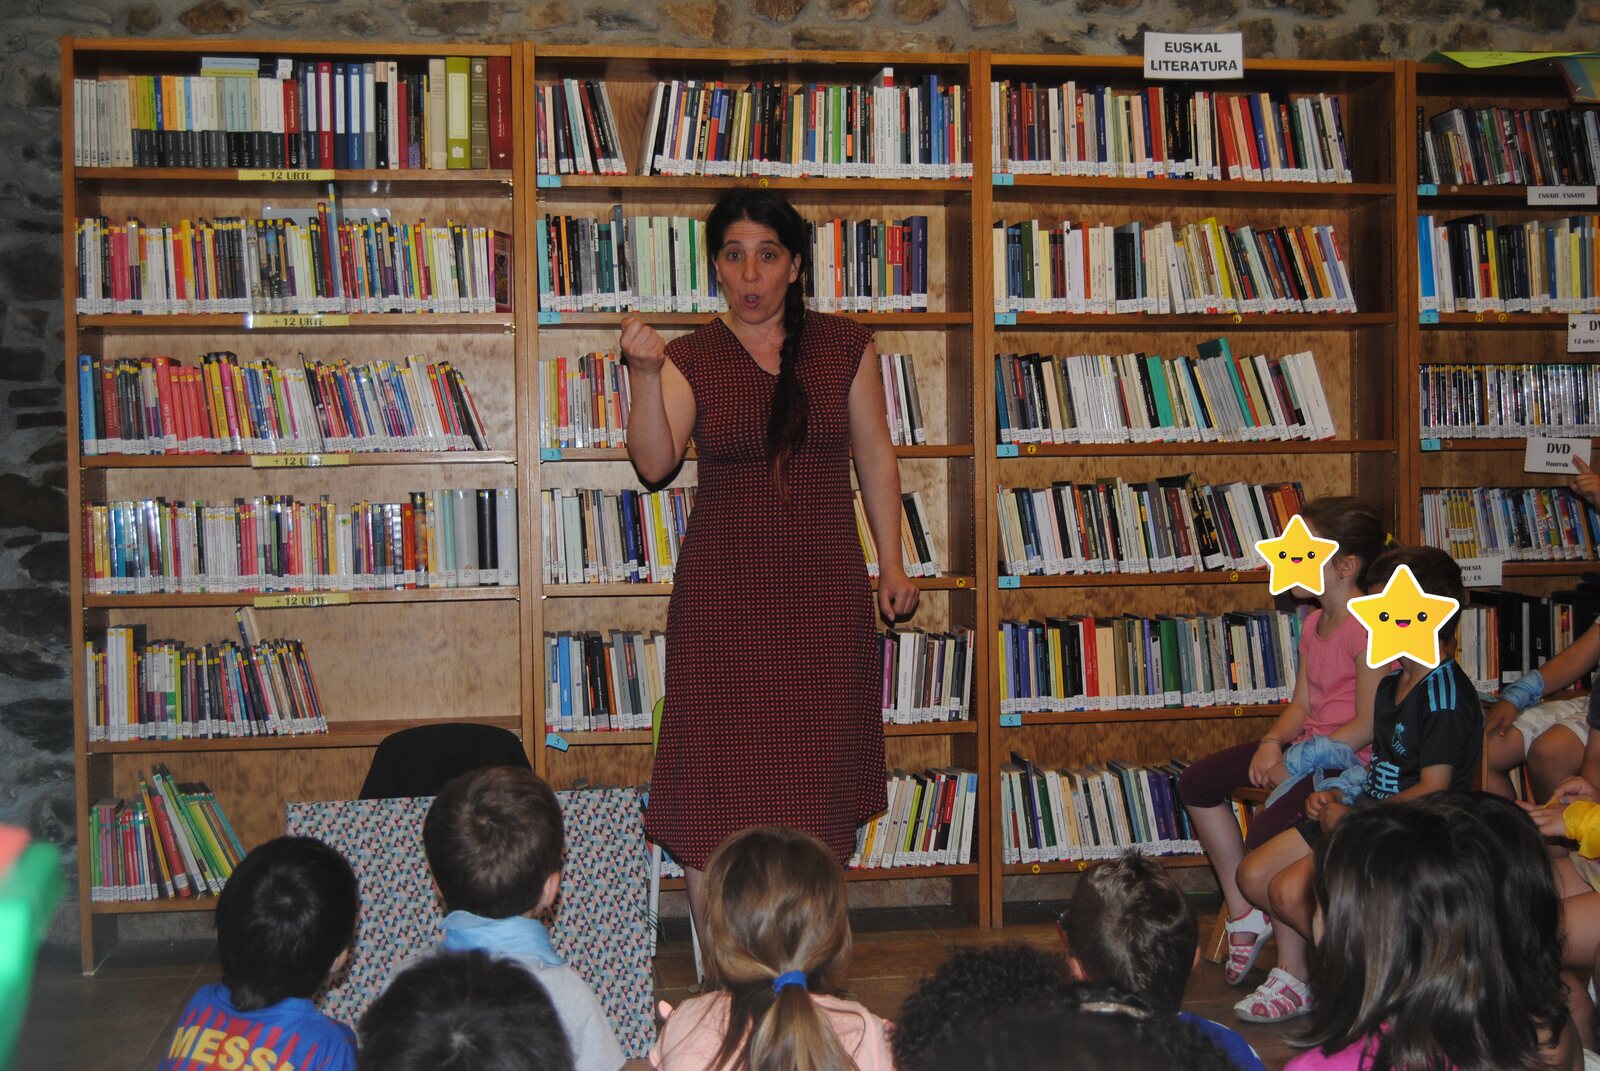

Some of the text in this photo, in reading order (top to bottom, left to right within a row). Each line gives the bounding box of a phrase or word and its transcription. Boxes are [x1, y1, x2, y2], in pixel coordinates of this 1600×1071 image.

[1164, 41, 1222, 53] EUSKAL
[1150, 60, 1238, 72] LITERATURA
[270, 171, 283, 179] 12
[286, 172, 312, 180] URTE
[283, 317, 296, 326] 12
[299, 317, 324, 326] URTE
[1546, 443, 1571, 454] DVD
[283, 457, 296, 465] 12
[285, 597, 298, 606] 12
